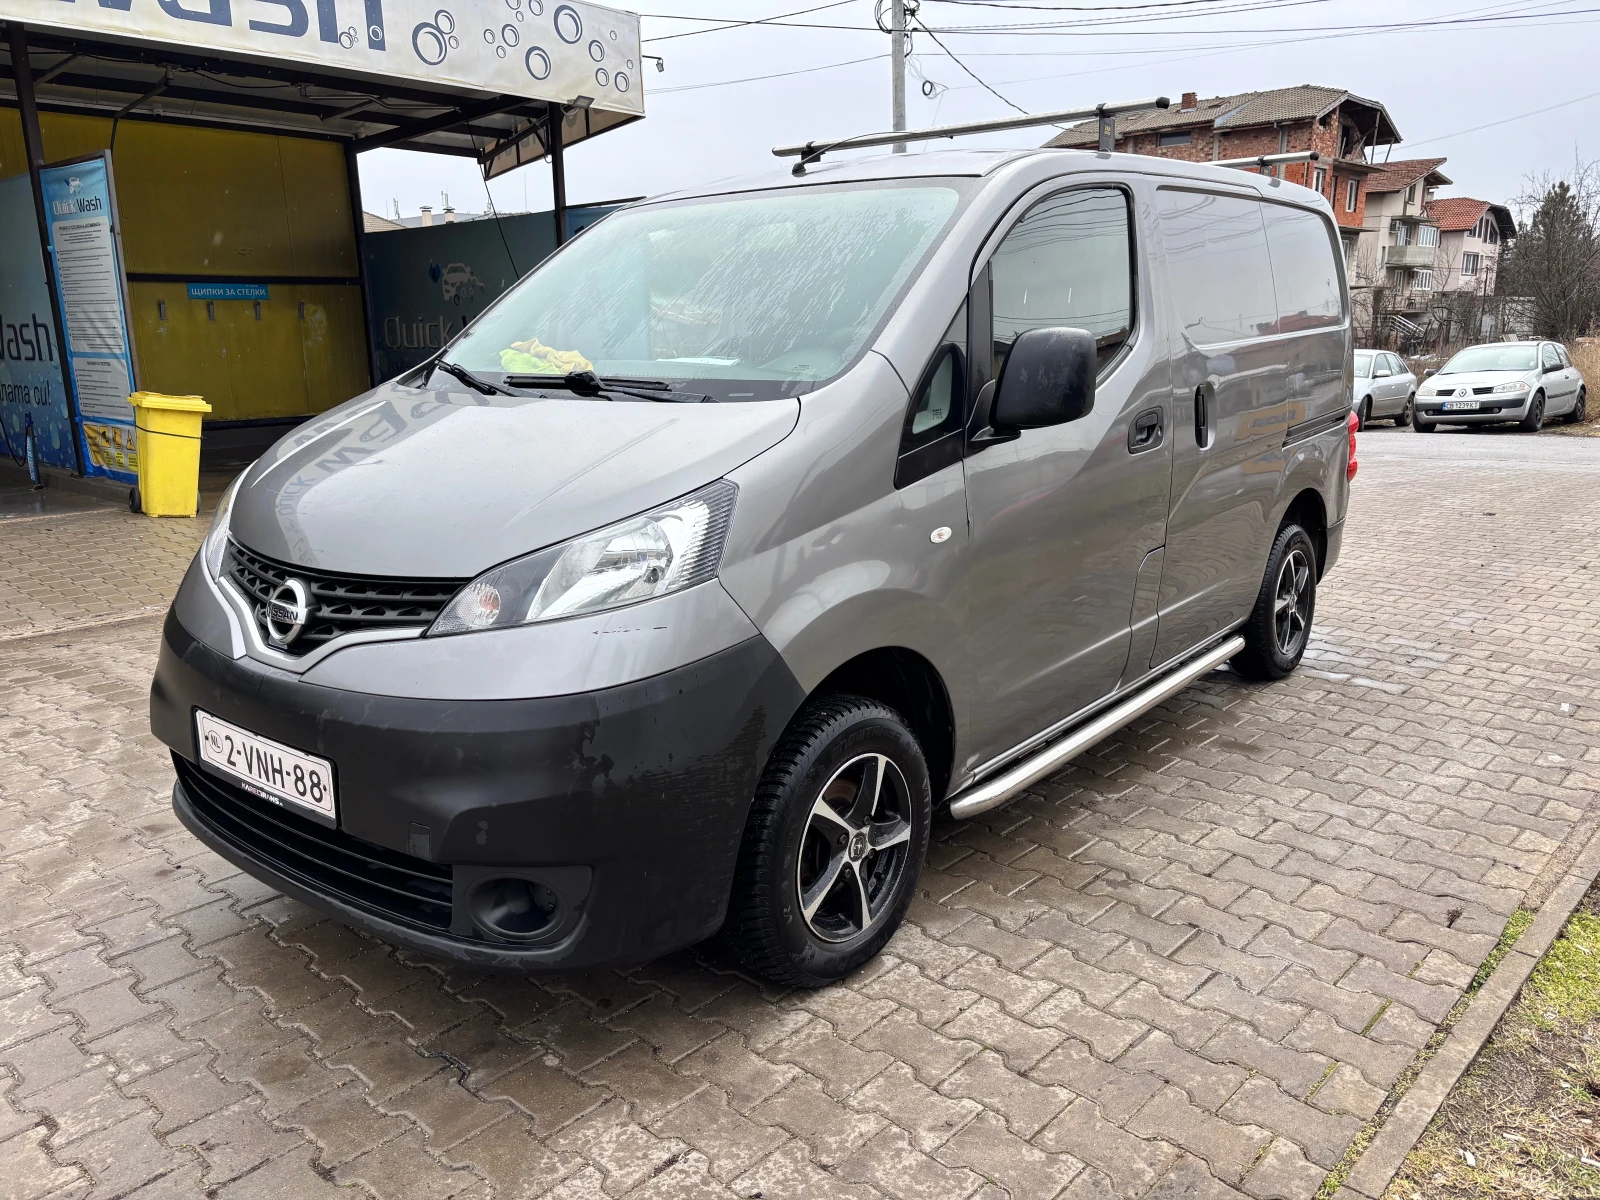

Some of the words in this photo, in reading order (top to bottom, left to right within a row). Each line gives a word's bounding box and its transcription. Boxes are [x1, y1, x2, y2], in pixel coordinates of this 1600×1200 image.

[52, 200, 77, 215] Quick
[76, 196, 102, 213] Wash
[191, 288, 224, 296] ЩИПКИ
[225, 288, 236, 296] ЗА
[236, 288, 266, 296] СТЕЛКИ
[384, 316, 454, 350] Quick
[210, 733, 221, 749] NL
[224, 734, 324, 803] 2-VNH-88
